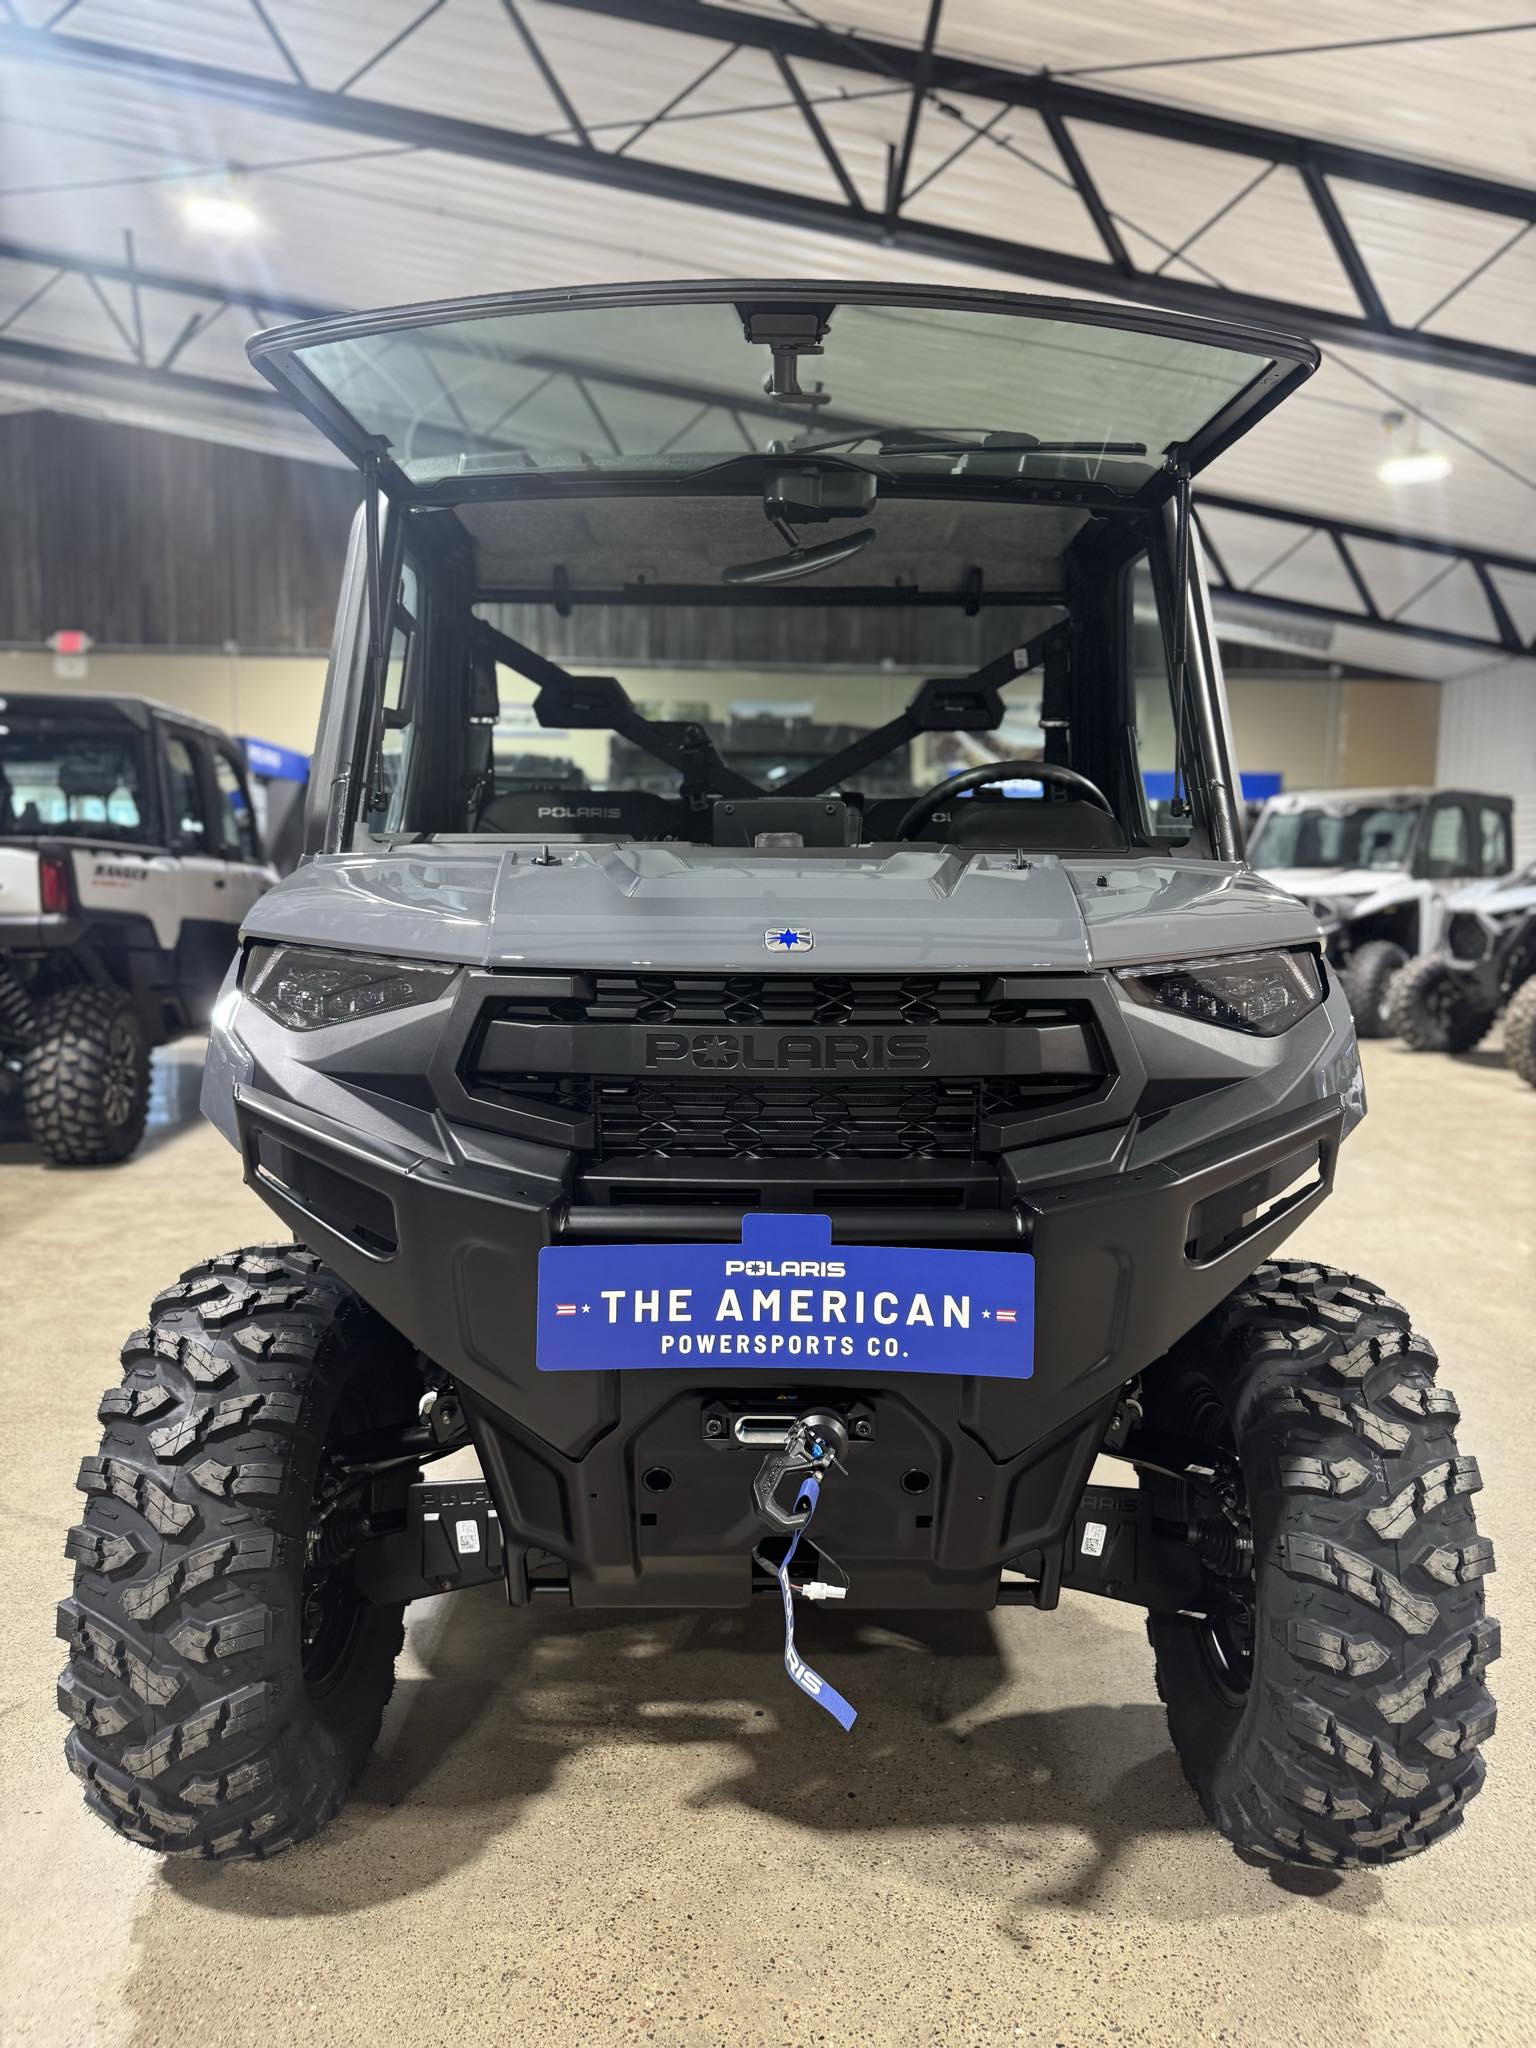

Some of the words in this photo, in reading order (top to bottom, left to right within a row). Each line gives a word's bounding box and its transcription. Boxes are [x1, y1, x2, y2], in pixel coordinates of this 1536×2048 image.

[537, 806, 622, 819] POLARIS
[645, 1032, 931, 1071] POLARIS
[725, 1259, 846, 1278] POLARIS
[600, 1288, 693, 1324] THE
[715, 1289, 971, 1329] AMERICAN
[661, 1334, 854, 1356] POWERSPORTS
[867, 1336, 909, 1358] CO.
